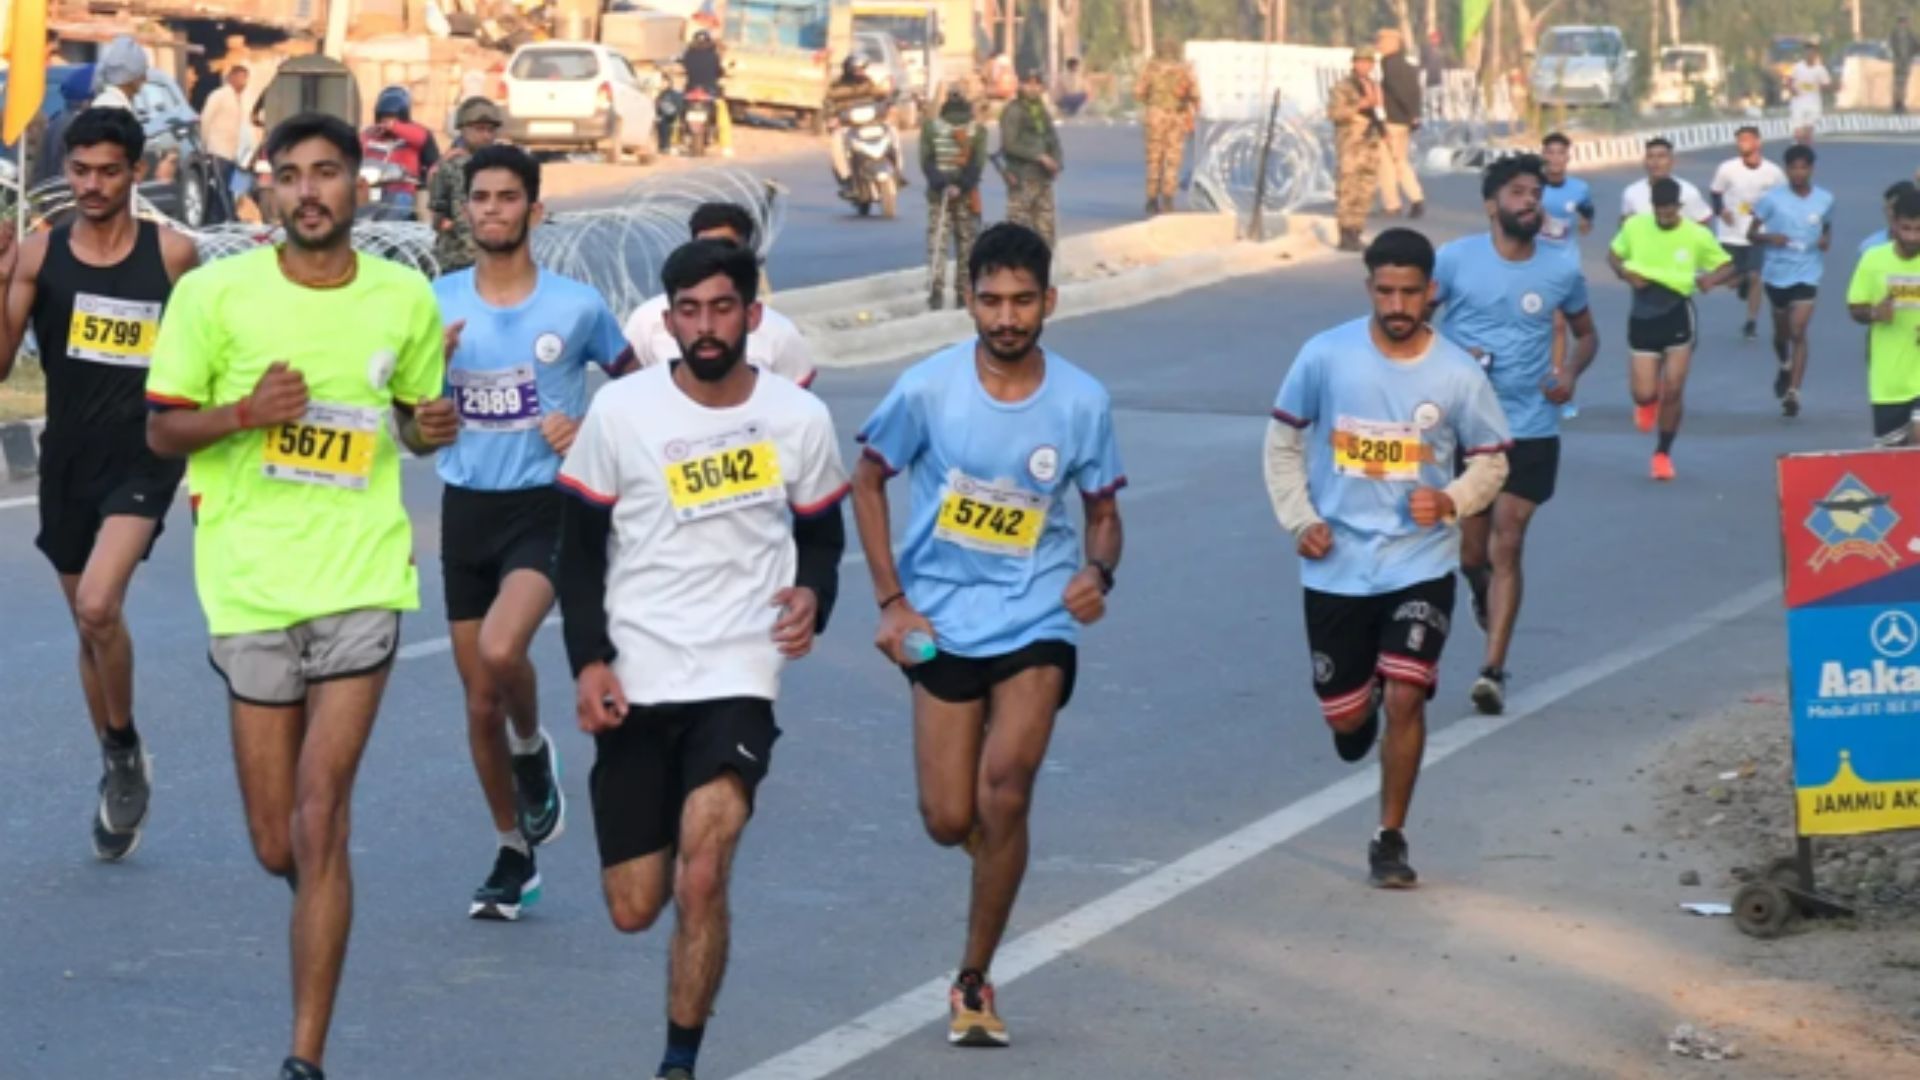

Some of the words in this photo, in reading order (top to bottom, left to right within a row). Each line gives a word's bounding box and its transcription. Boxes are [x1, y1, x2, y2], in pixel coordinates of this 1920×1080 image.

[83, 316, 141, 346] 5799
[463, 387, 521, 414] 2989
[279, 422, 351, 463] 5671
[682, 449, 758, 493] 5642
[955, 498, 1025, 535] 5742
[1814, 791, 1885, 815] JAMMU
